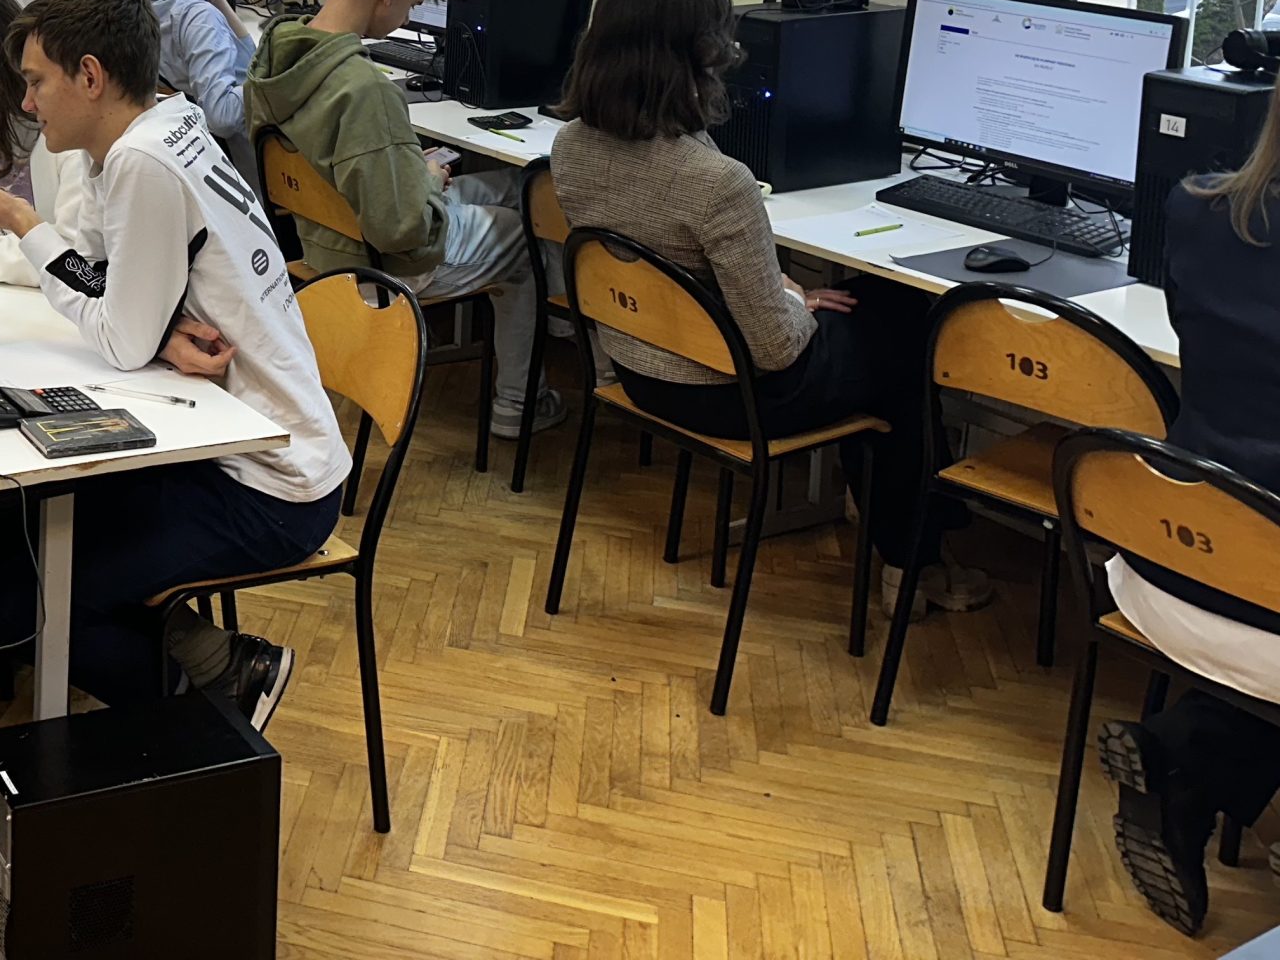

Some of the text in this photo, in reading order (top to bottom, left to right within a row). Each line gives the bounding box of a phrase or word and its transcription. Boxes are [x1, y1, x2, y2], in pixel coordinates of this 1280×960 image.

[1166, 119, 1179, 133] 14
[1004, 161, 1018, 169] DELL
[281, 172, 300, 192] 103
[609, 287, 638, 313] 103
[1006, 352, 1049, 381] 103
[1159, 518, 1214, 555] 103
